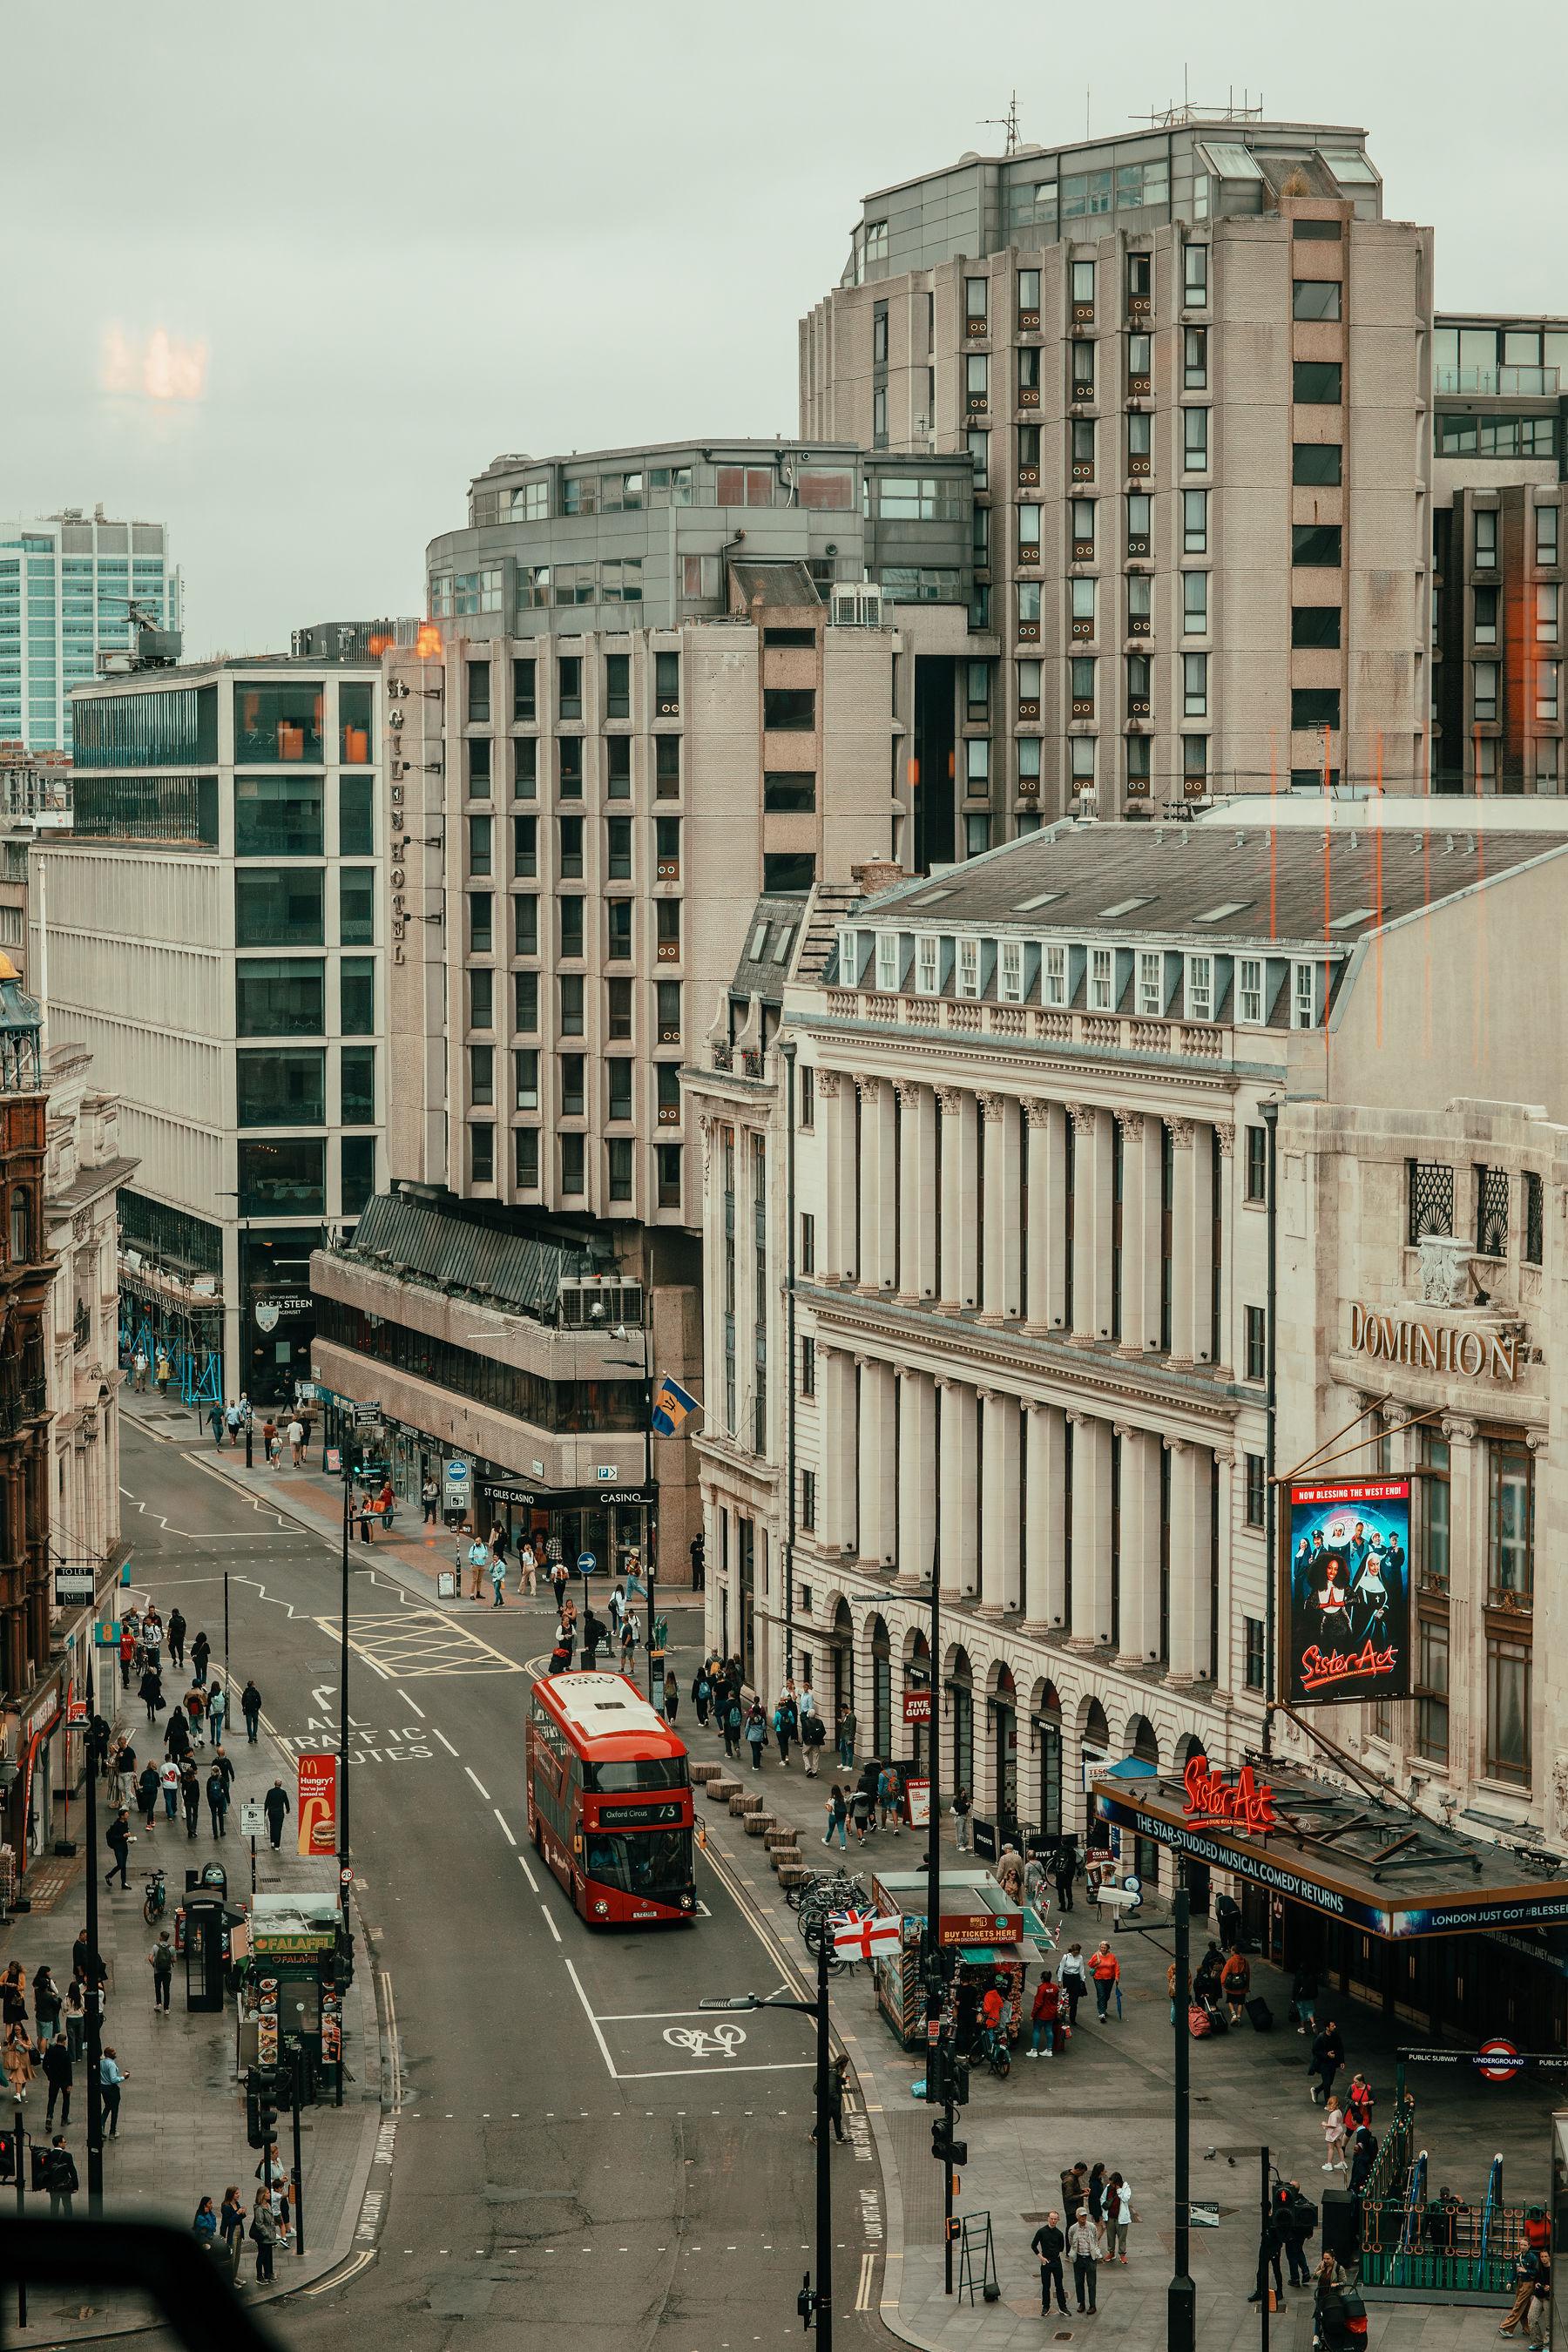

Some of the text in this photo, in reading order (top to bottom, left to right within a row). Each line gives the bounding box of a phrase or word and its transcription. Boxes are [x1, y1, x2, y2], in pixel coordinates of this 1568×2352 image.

[389, 842, 406, 964] HOTEL
[284, 1300, 313, 1308] STEEN
[1348, 1301, 1518, 1382] DOMINION
[484, 1487, 534, 1504] ST GILES CASINO
[600, 1493, 641, 1504] CASINO
[1299, 1486, 1402, 1500] NOW BLESSING THE WEST END!
[1300, 1639, 1399, 1680] Sister Act
[906, 1707, 931, 1716] GUYS
[908, 1700, 929, 1709] FIVE
[308, 1714, 373, 1730] ALL
[300, 1777, 334, 1786] Hungry?
[1183, 1755, 1278, 1835] Sister Act
[605, 1809, 648, 1819] Oxford Circus
[658, 1804, 675, 1818] 73
[1135, 1812, 1152, 1834] THE
[1153, 1820, 1218, 1860] STAR-STUDDED
[1220, 1846, 1260, 1878] MUSICAL
[1260, 1863, 1301, 1894] COMEDY
[1301, 1880, 1344, 1913] RETURNS
[1431, 1912, 1477, 1926] LONDON
[1477, 1910, 1502, 1922] JUST
[1503, 1909, 1524, 1919] GOT
[1472, 2057, 1524, 2065] UNDERGROUND
[363, 2190, 385, 2206] LOOK
[864, 2223, 883, 2239] LOOK
